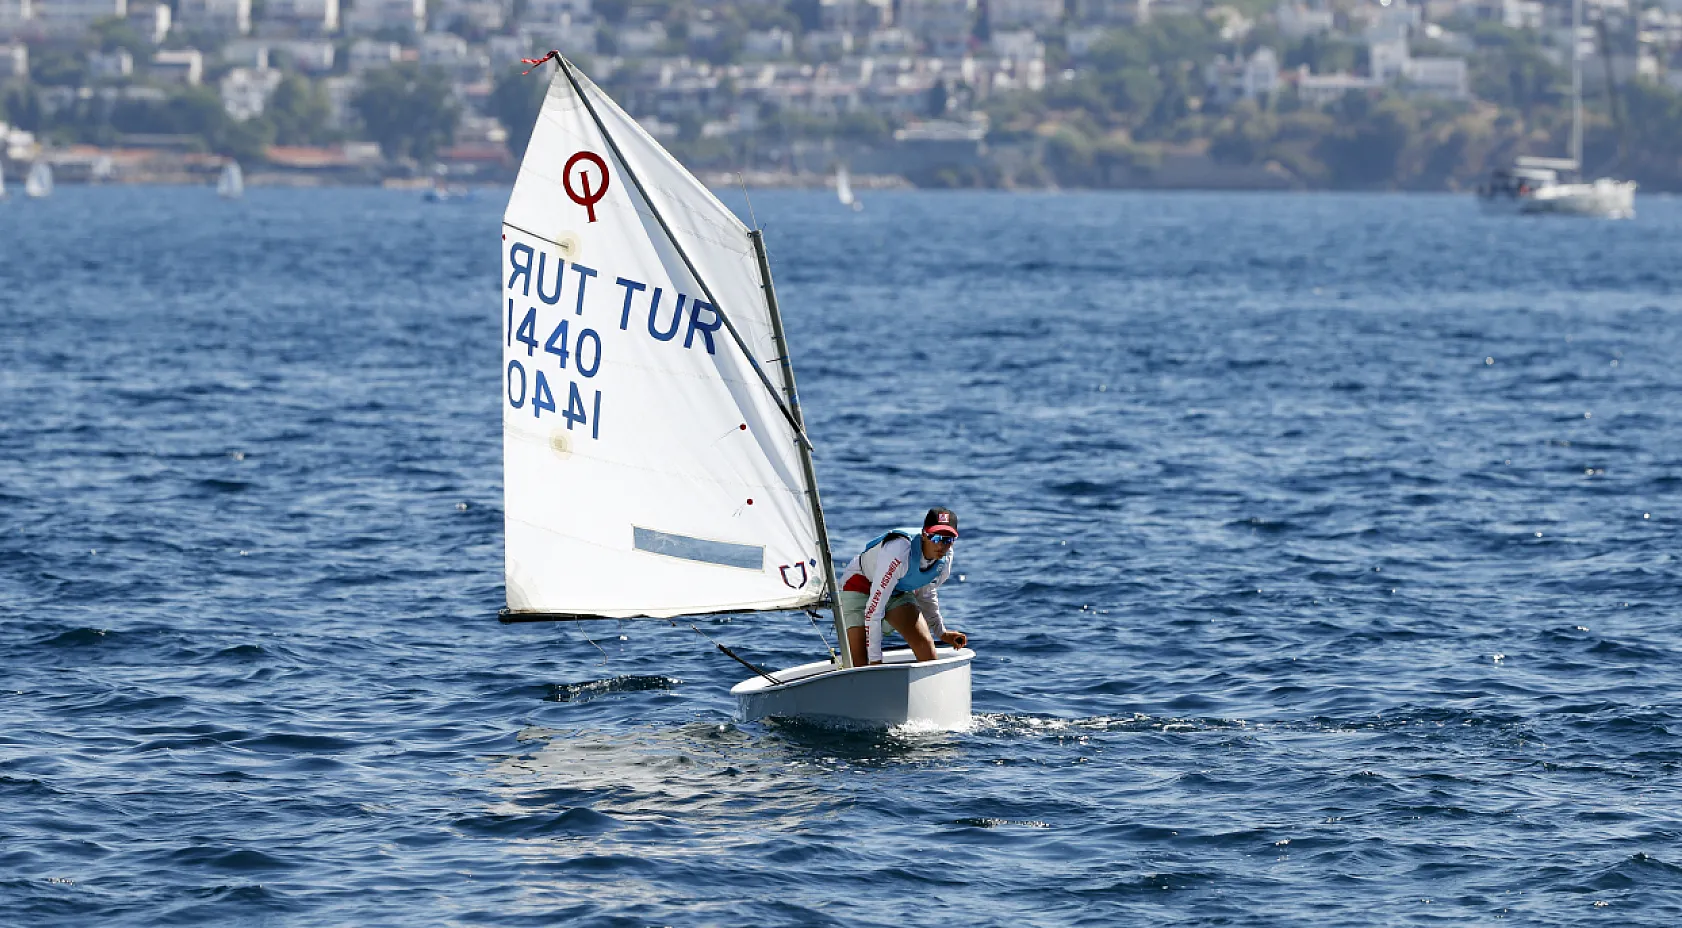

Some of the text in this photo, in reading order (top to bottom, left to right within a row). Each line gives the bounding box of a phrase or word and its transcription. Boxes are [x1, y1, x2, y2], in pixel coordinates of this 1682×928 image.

[508, 298, 602, 378] 1440
[616, 276, 723, 355] TUR
[880, 557, 902, 589] TURKISH
